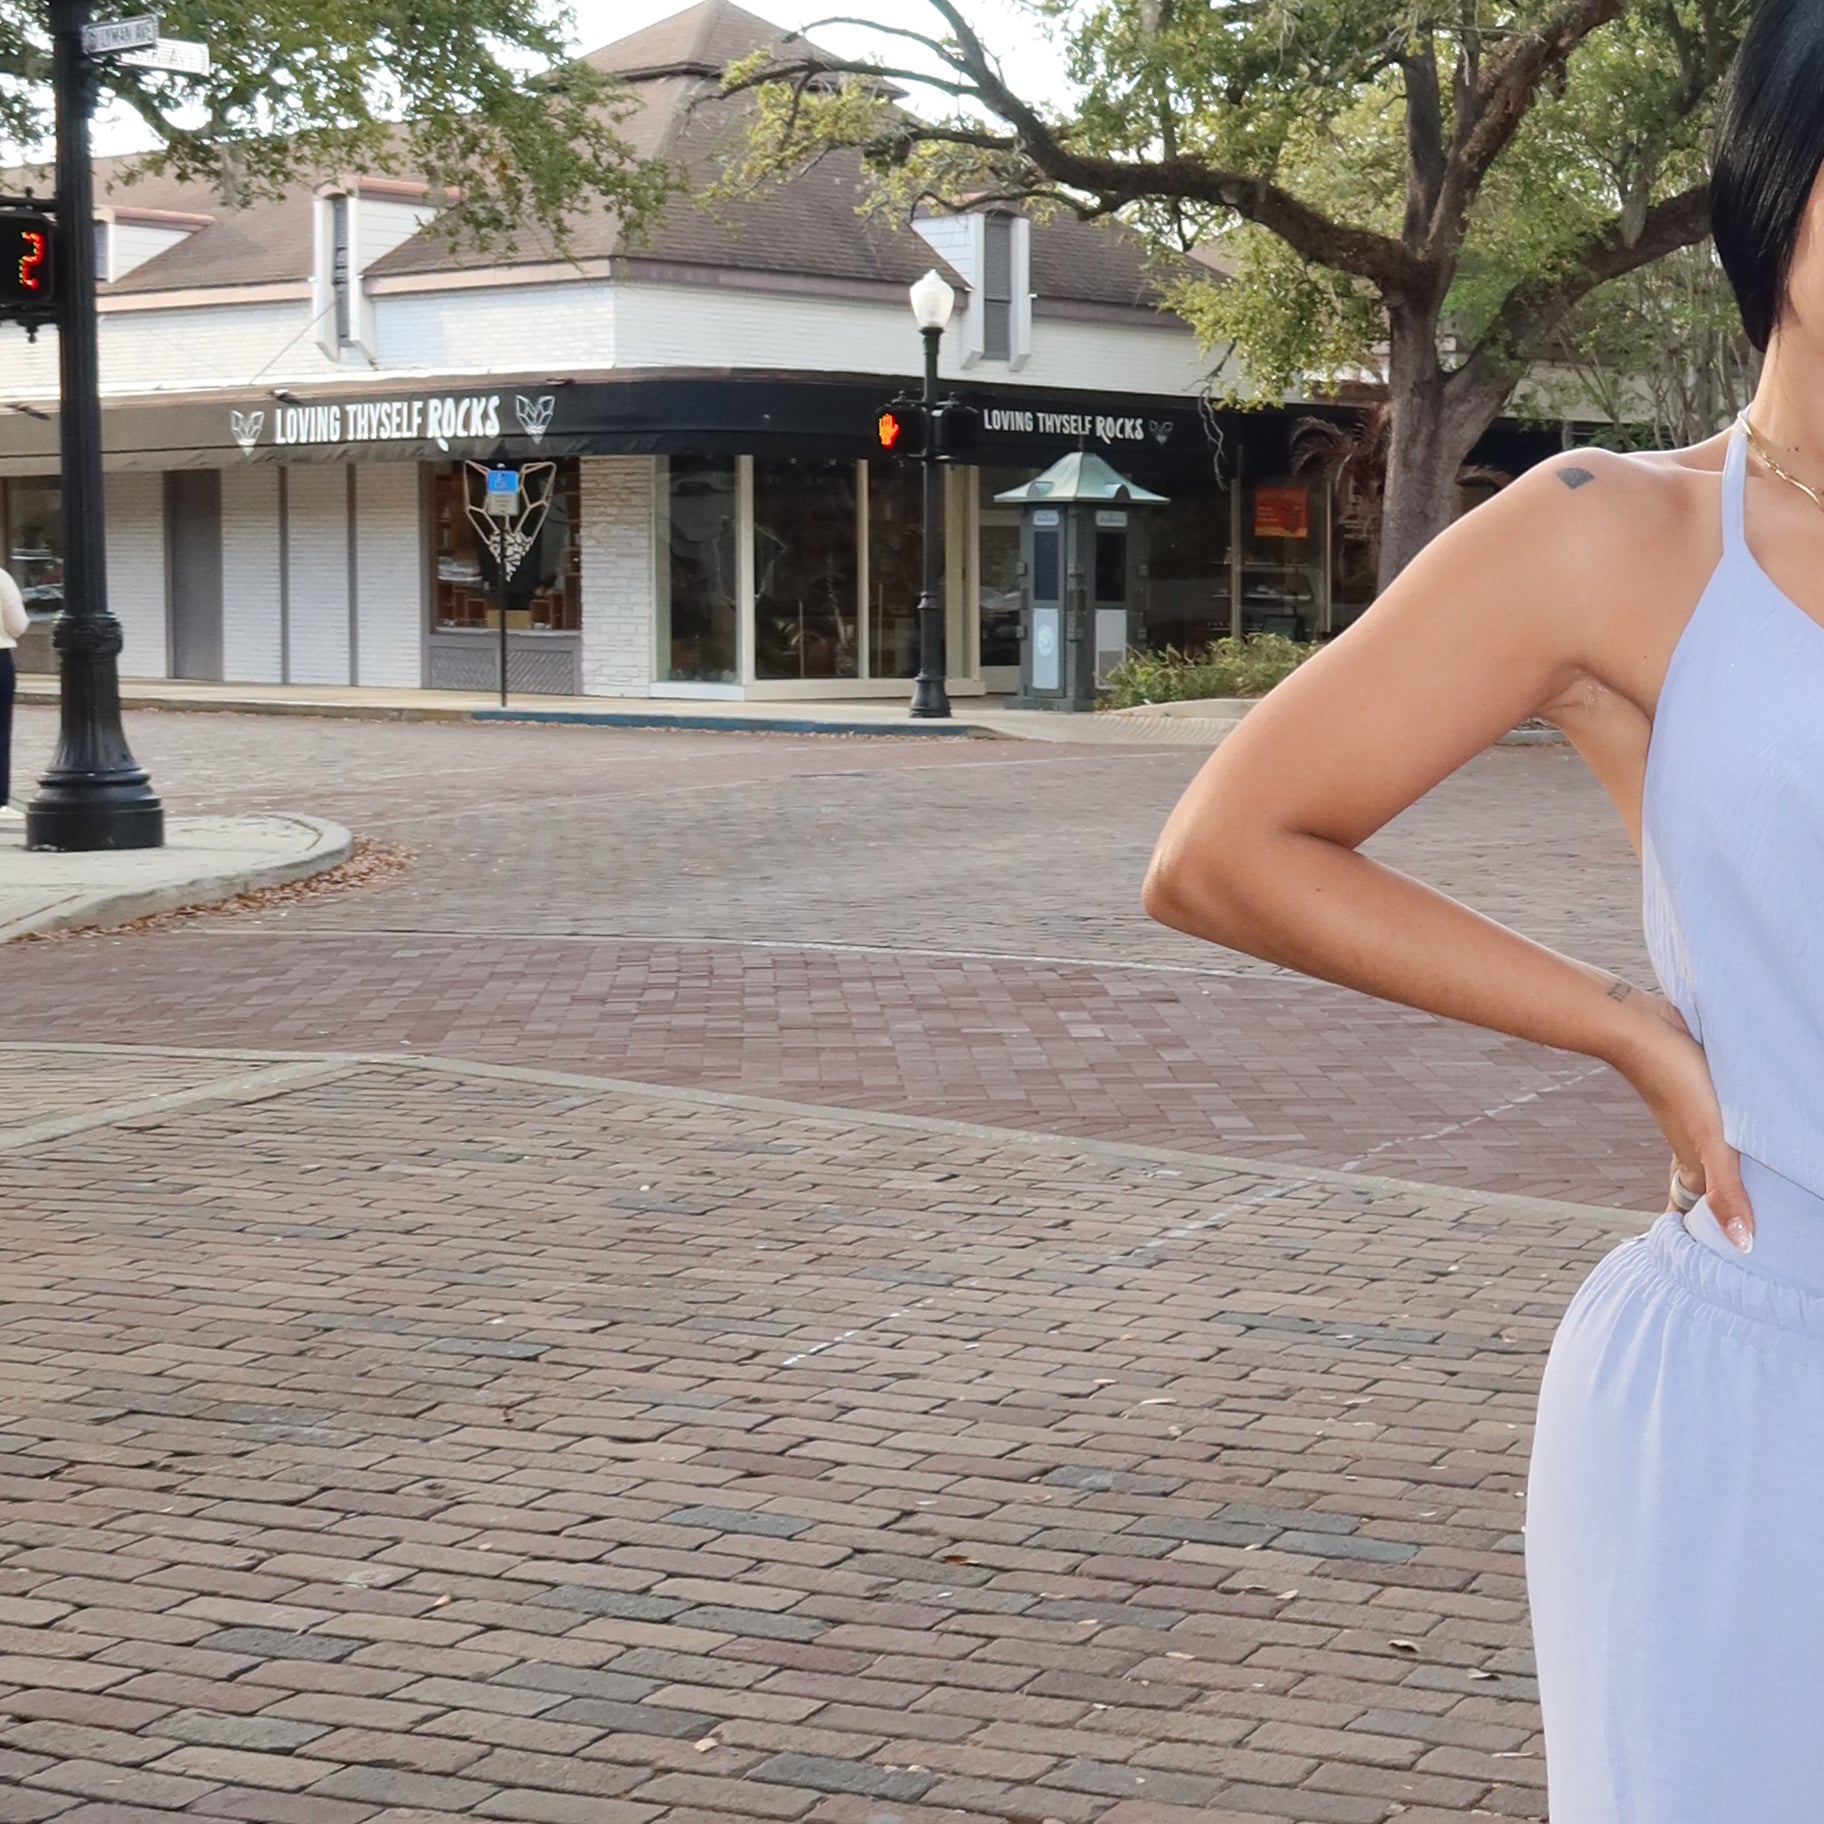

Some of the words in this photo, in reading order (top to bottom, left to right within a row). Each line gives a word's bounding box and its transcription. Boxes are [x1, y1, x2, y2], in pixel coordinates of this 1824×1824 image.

[19, 230, 45, 290] 2
[274, 405, 341, 445] LOVING
[345, 400, 423, 441] THYSELF
[426, 394, 501, 452] ROCKS
[983, 408, 1034, 434] LOVING
[1037, 411, 1093, 437] THYSELF
[1094, 415, 1145, 445] ROCKS
